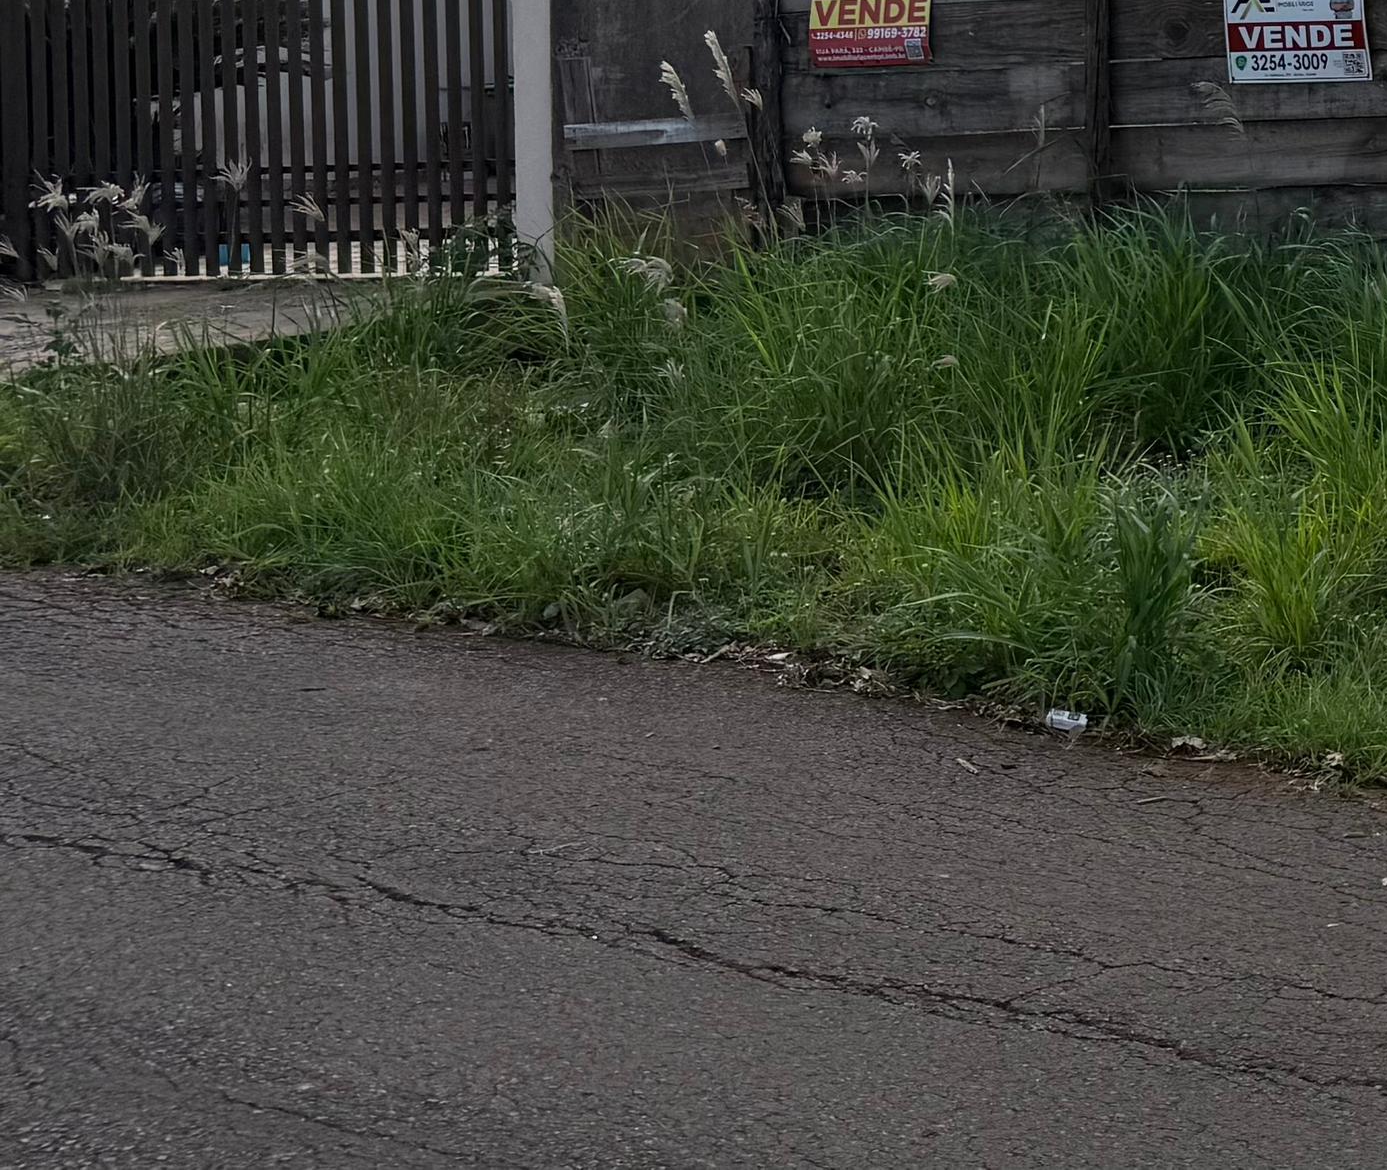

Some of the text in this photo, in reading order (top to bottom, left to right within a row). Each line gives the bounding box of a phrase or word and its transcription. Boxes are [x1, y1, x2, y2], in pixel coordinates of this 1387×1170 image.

[867, 27, 926, 40] 99169-3782
[1238, 24, 1354, 49] VENDE
[1251, 53, 1328, 72] 3254-3009
